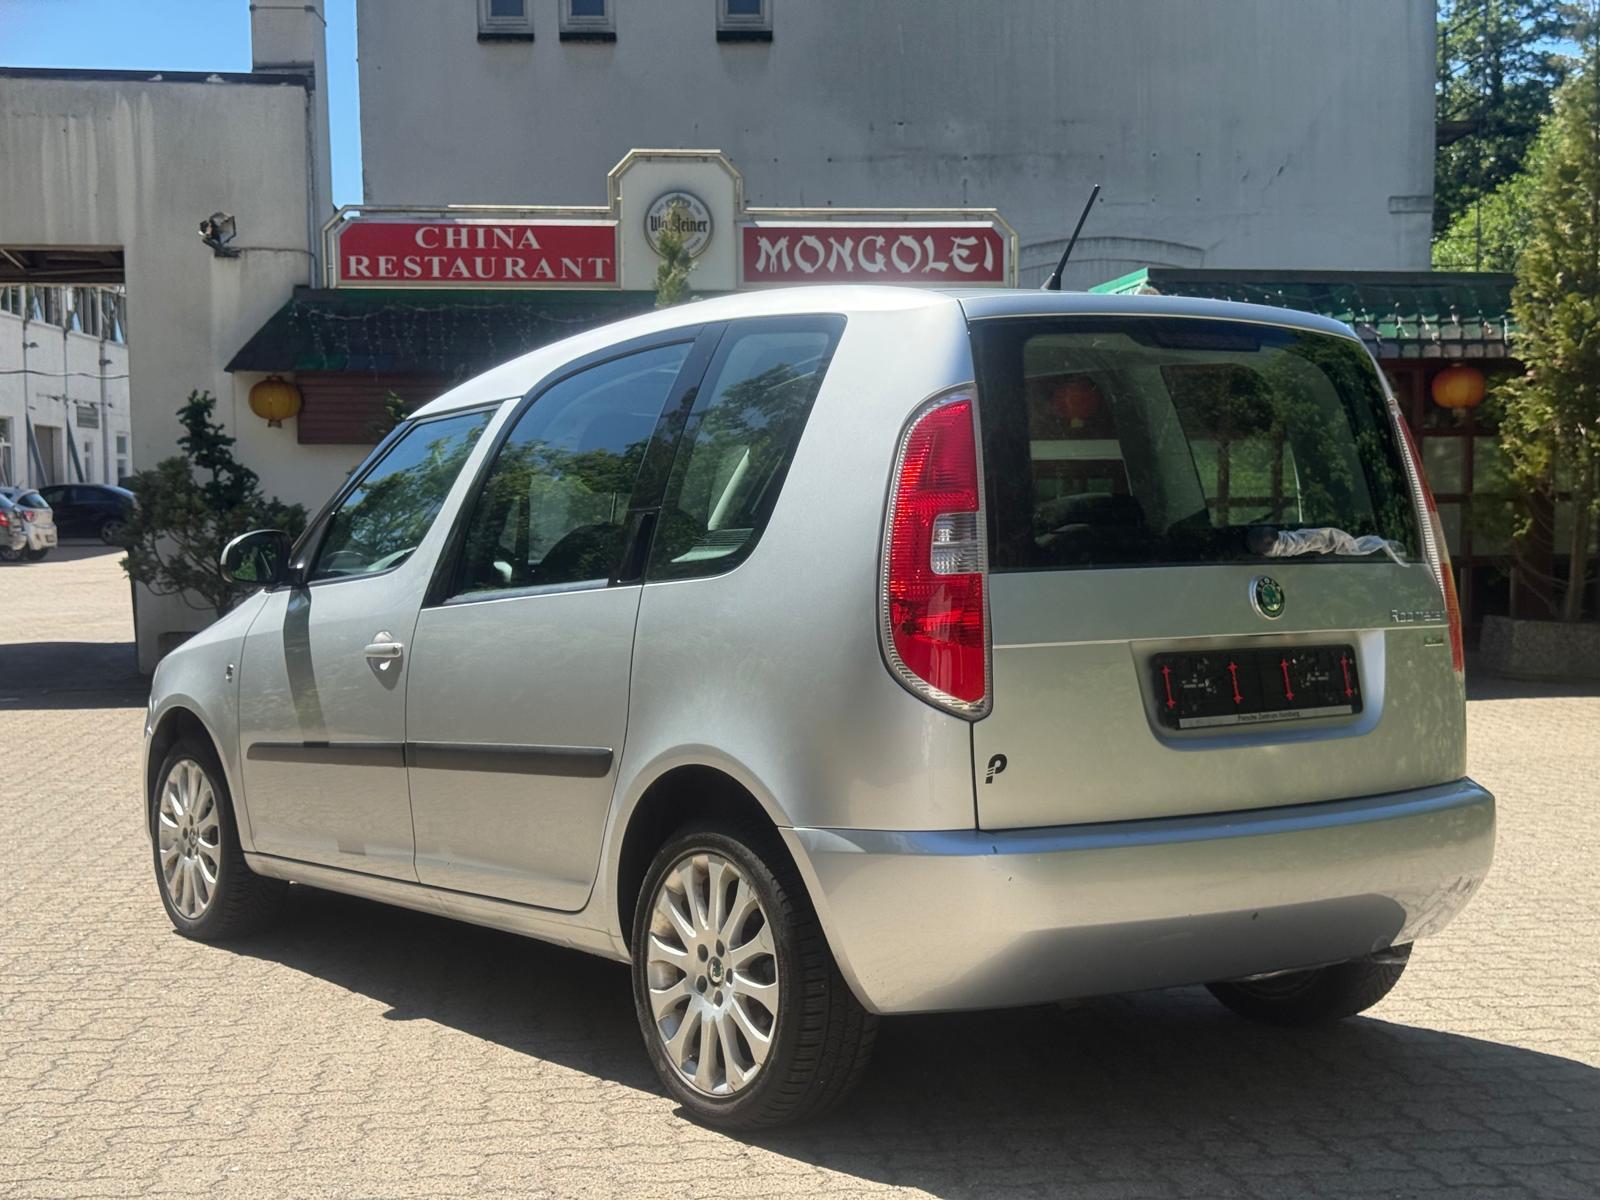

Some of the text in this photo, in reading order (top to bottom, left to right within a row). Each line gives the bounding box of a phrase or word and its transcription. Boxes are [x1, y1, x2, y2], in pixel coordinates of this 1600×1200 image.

[414, 227, 541, 250] CHINA
[754, 234, 993, 273] MONGOLEI
[349, 255, 610, 280] RESTAURANT
